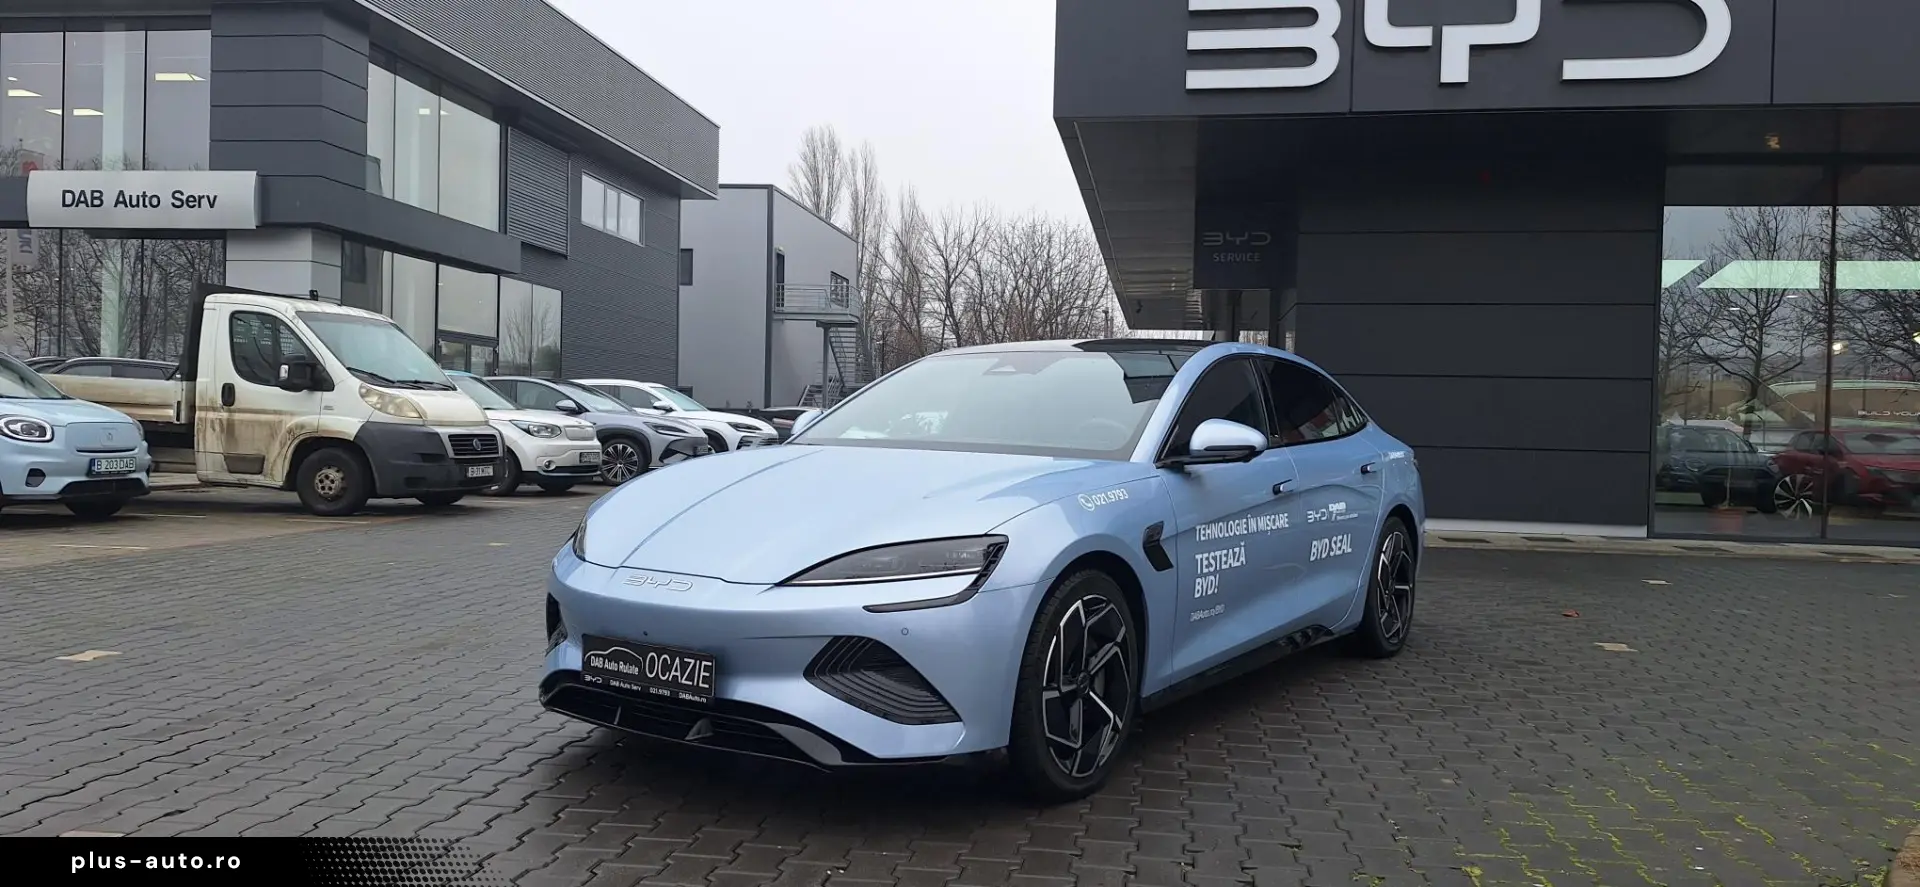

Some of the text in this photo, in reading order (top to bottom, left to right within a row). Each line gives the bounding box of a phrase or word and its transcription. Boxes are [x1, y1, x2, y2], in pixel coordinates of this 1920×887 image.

[1186, 0, 1731, 90] BYD
[61, 189, 218, 209] DAB Auto Serv
[1203, 232, 1271, 246] BYD
[1213, 252, 1261, 262] SERVICE
[96, 458, 135, 471] B 203 DAB
[1092, 488, 1129, 505] 021.9793
[1306, 509, 1328, 523] BYD
[1195, 513, 1289, 541] TEHNOLOGIE ÎN MIȘCARE
[1195, 540, 1246, 574] TESTEAZĂ
[1310, 533, 1352, 562] BYD SEAL
[622, 574, 694, 592] BYD
[1194, 573, 1219, 598] BYD!
[590, 655, 639, 675] DAB Auto Rulate
[645, 651, 713, 689] OCAZIE
[584, 674, 603, 684] BYD
[609, 679, 620, 687] DAB
[619, 681, 631, 690] Auto
[630, 682, 642, 692] Serv
[649, 686, 671, 697] 021.9793
